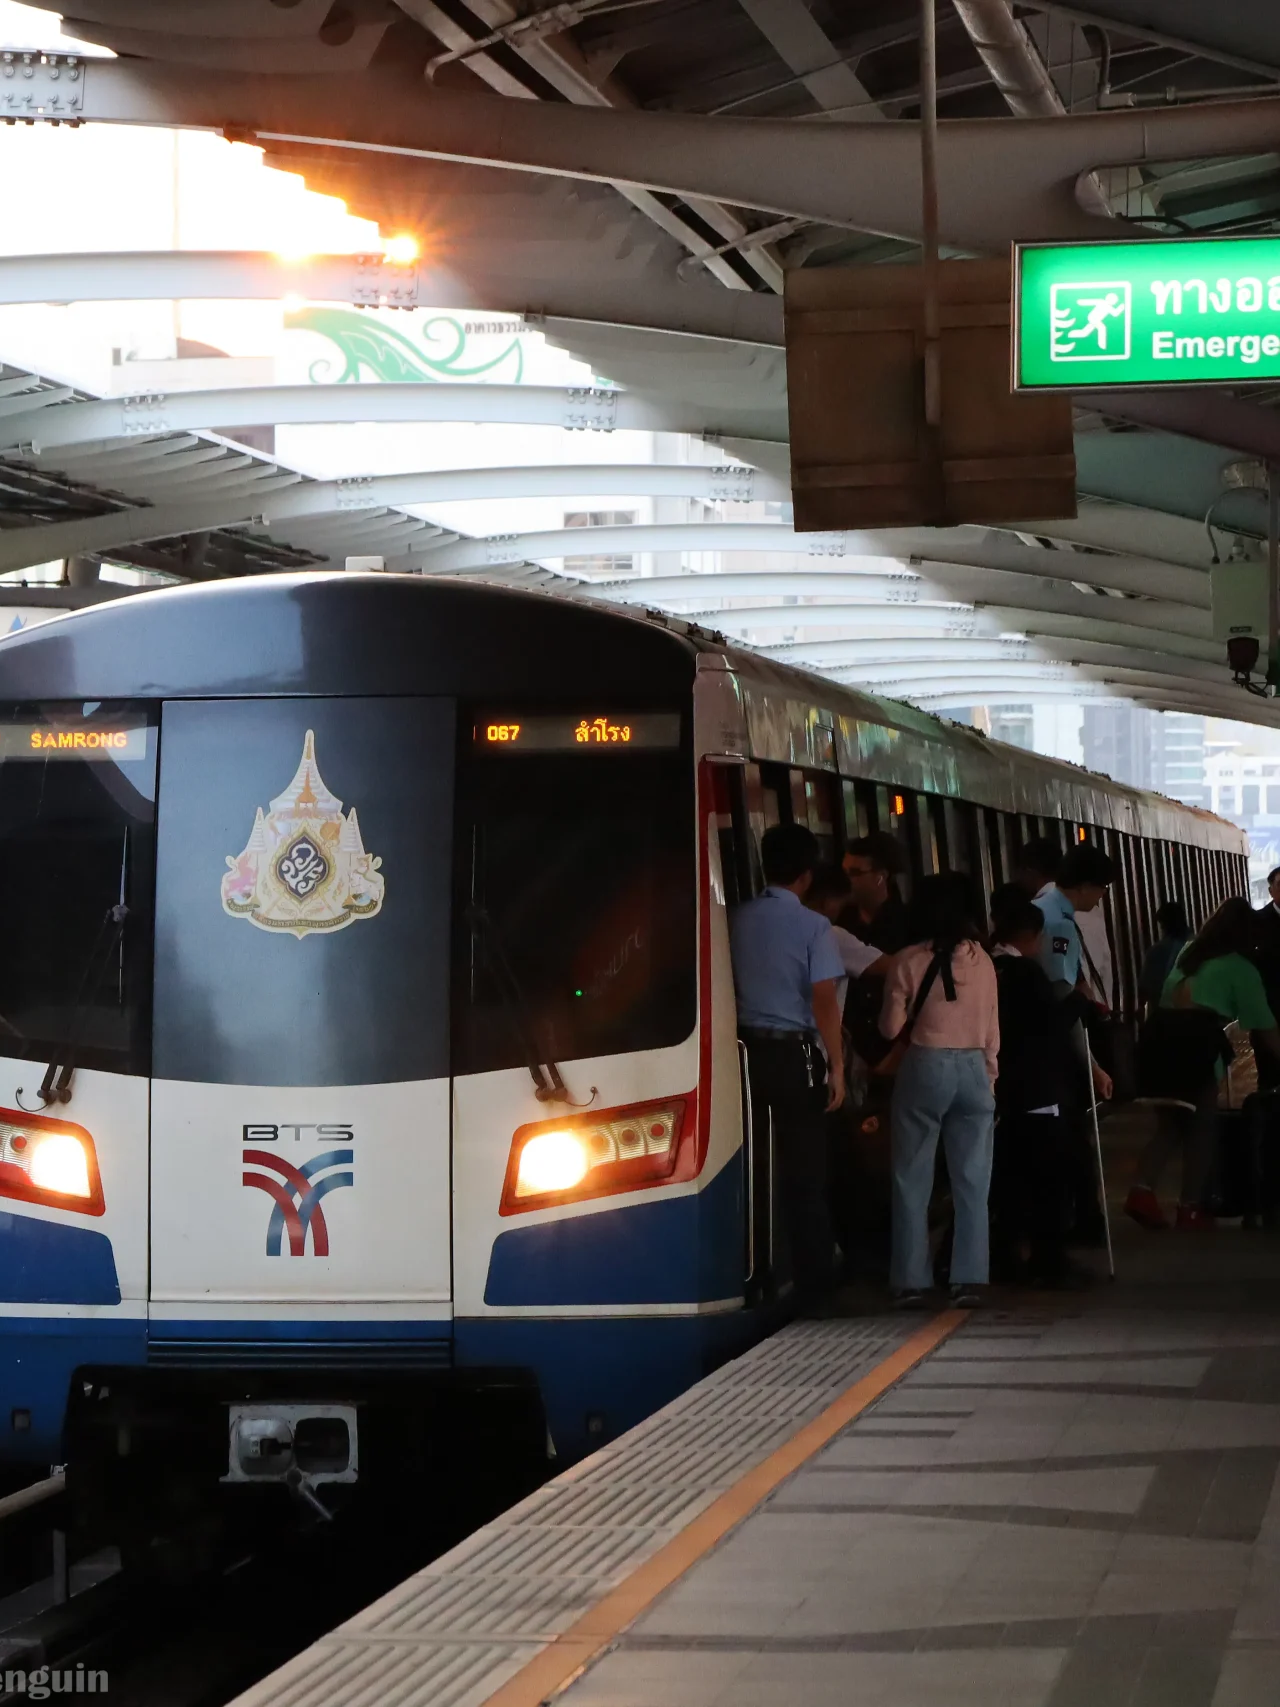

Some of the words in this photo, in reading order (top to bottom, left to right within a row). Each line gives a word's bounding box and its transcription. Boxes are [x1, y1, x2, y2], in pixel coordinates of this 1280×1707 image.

[1152, 331, 1280, 364] Emerge
[30, 732, 128, 748] SAMRONG
[487, 725, 520, 741] 067
[574, 717, 631, 742] สำโรง
[242, 1124, 354, 1142] BTS
